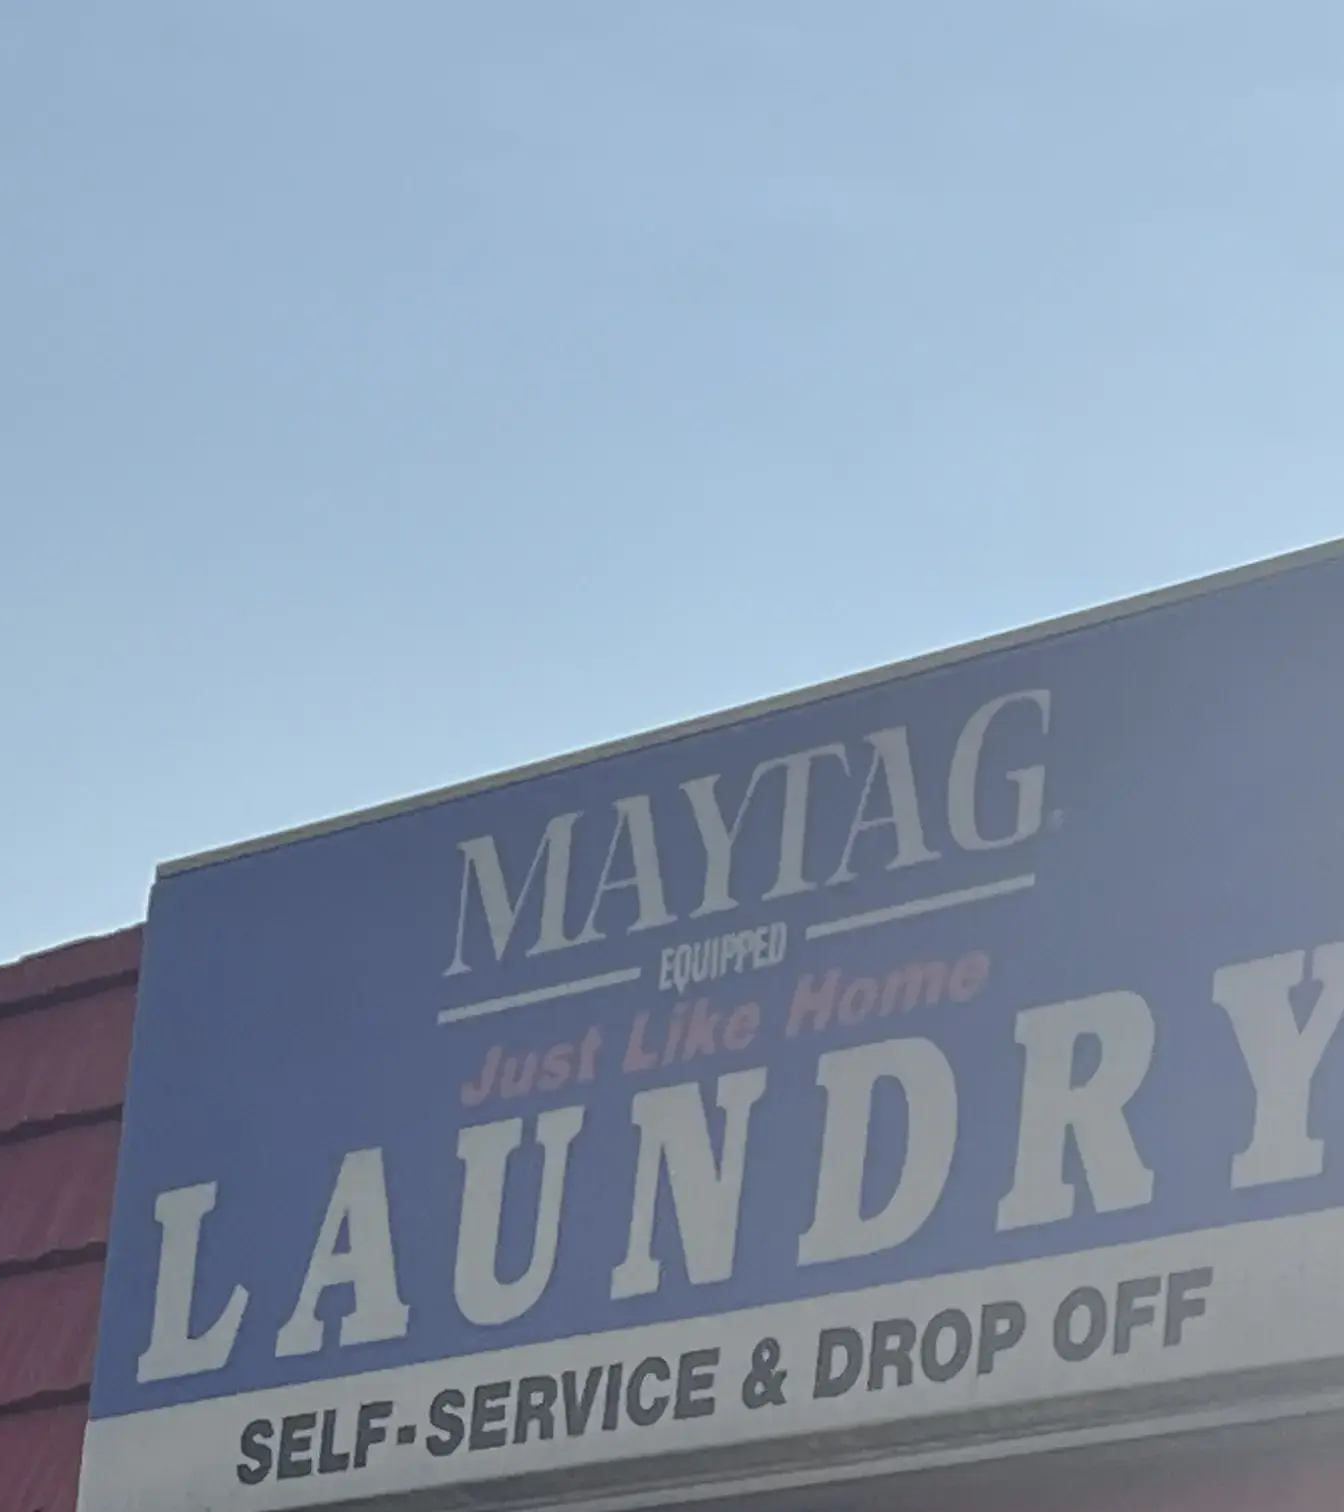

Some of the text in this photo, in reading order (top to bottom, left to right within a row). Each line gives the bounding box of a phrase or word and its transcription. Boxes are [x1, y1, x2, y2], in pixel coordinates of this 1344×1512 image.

[441, 689, 1051, 978] MAYTAG
[460, 949, 991, 1108] Just Like Home
[658, 920, 787, 995] EQUIPPED
[236, 1266, 1215, 1486] SELF-SERVICE & DROP OFF
